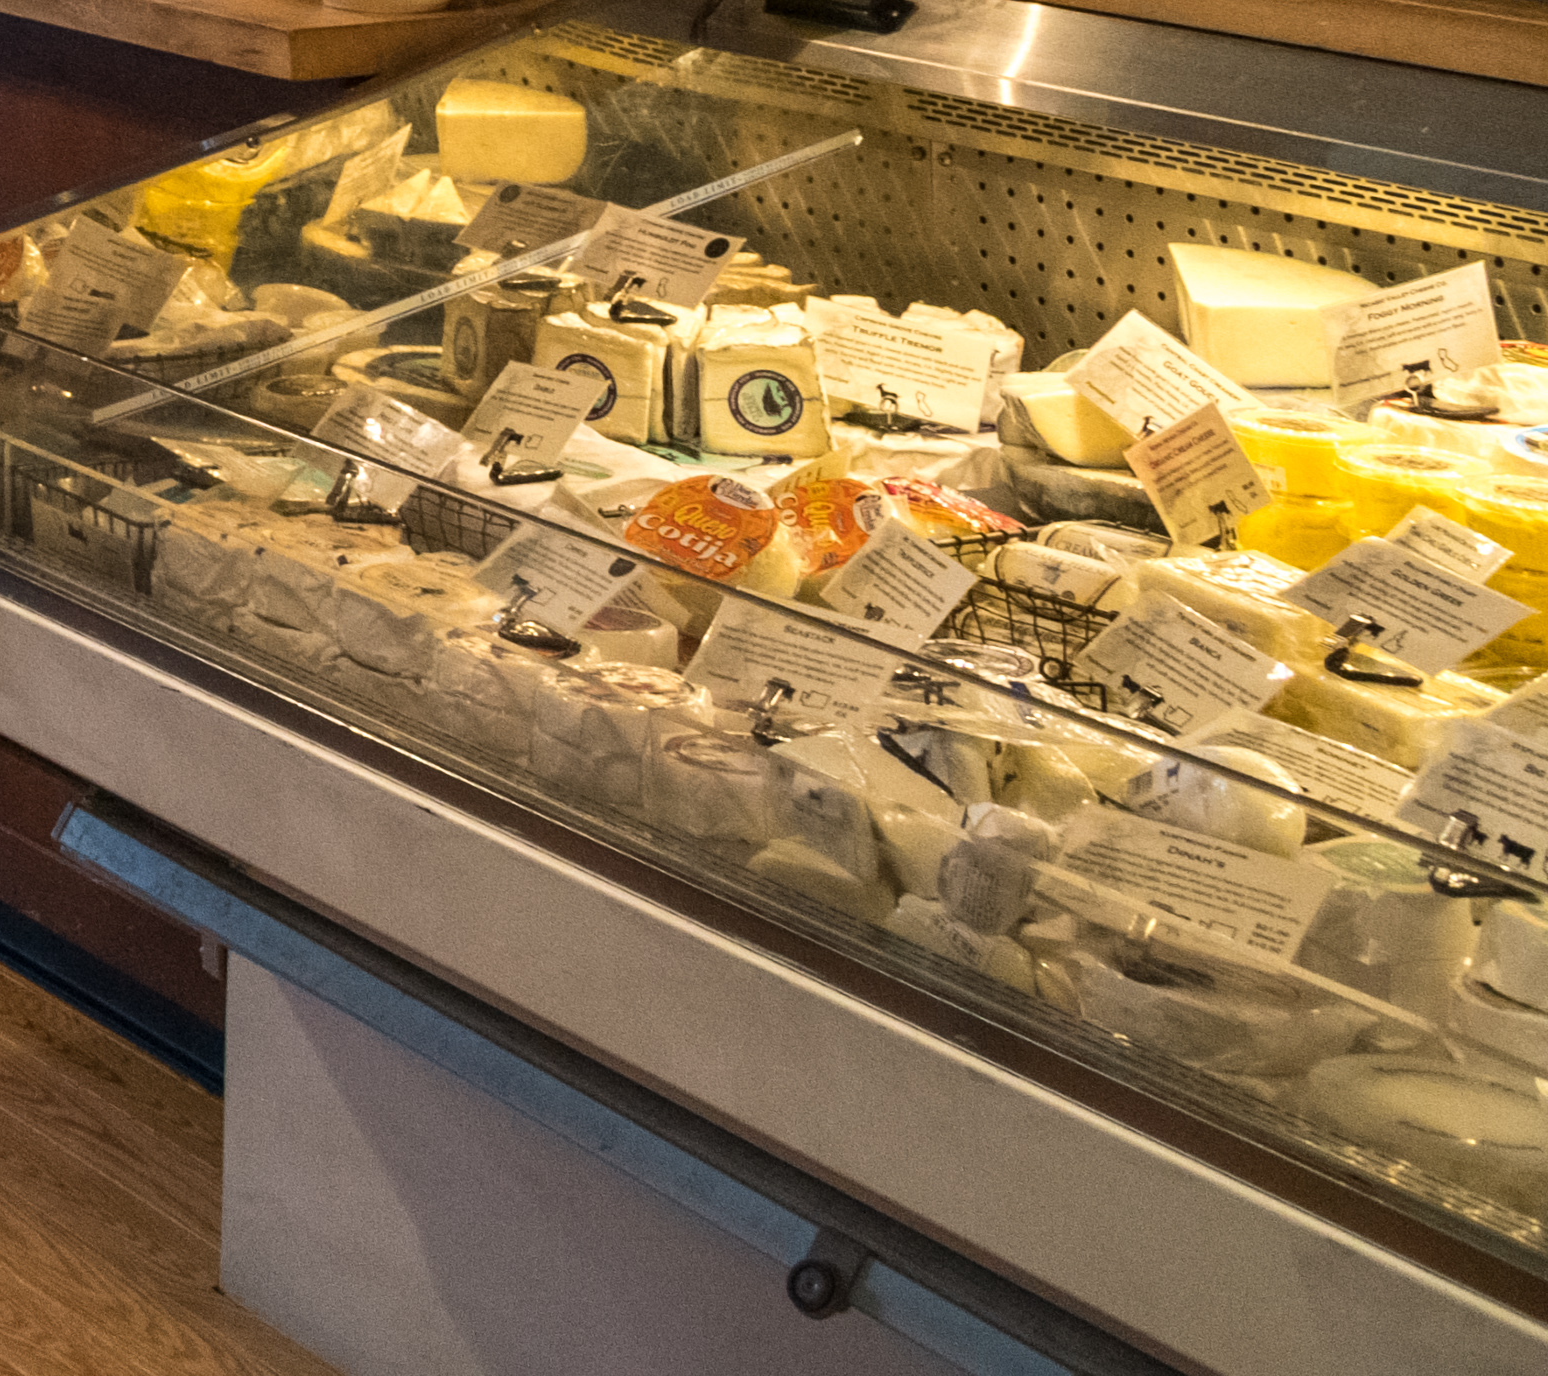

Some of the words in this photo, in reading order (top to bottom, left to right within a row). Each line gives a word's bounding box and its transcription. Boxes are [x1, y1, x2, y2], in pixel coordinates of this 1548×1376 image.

[1367, 306, 1399, 321] FOGGY
[1400, 295, 1445, 313] MORNING
[852, 324, 897, 343] TRUFFLE
[900, 336, 944, 353] TREMOR
[1163, 360, 1189, 381] GOAT
[674, 503, 738, 540] Queso
[637, 513, 738, 569] Cotija
[1391, 569, 1429, 592] GOLDEN
[784, 625, 836, 644] SEASTACK
[1167, 846, 1225, 868] DINAH'S
